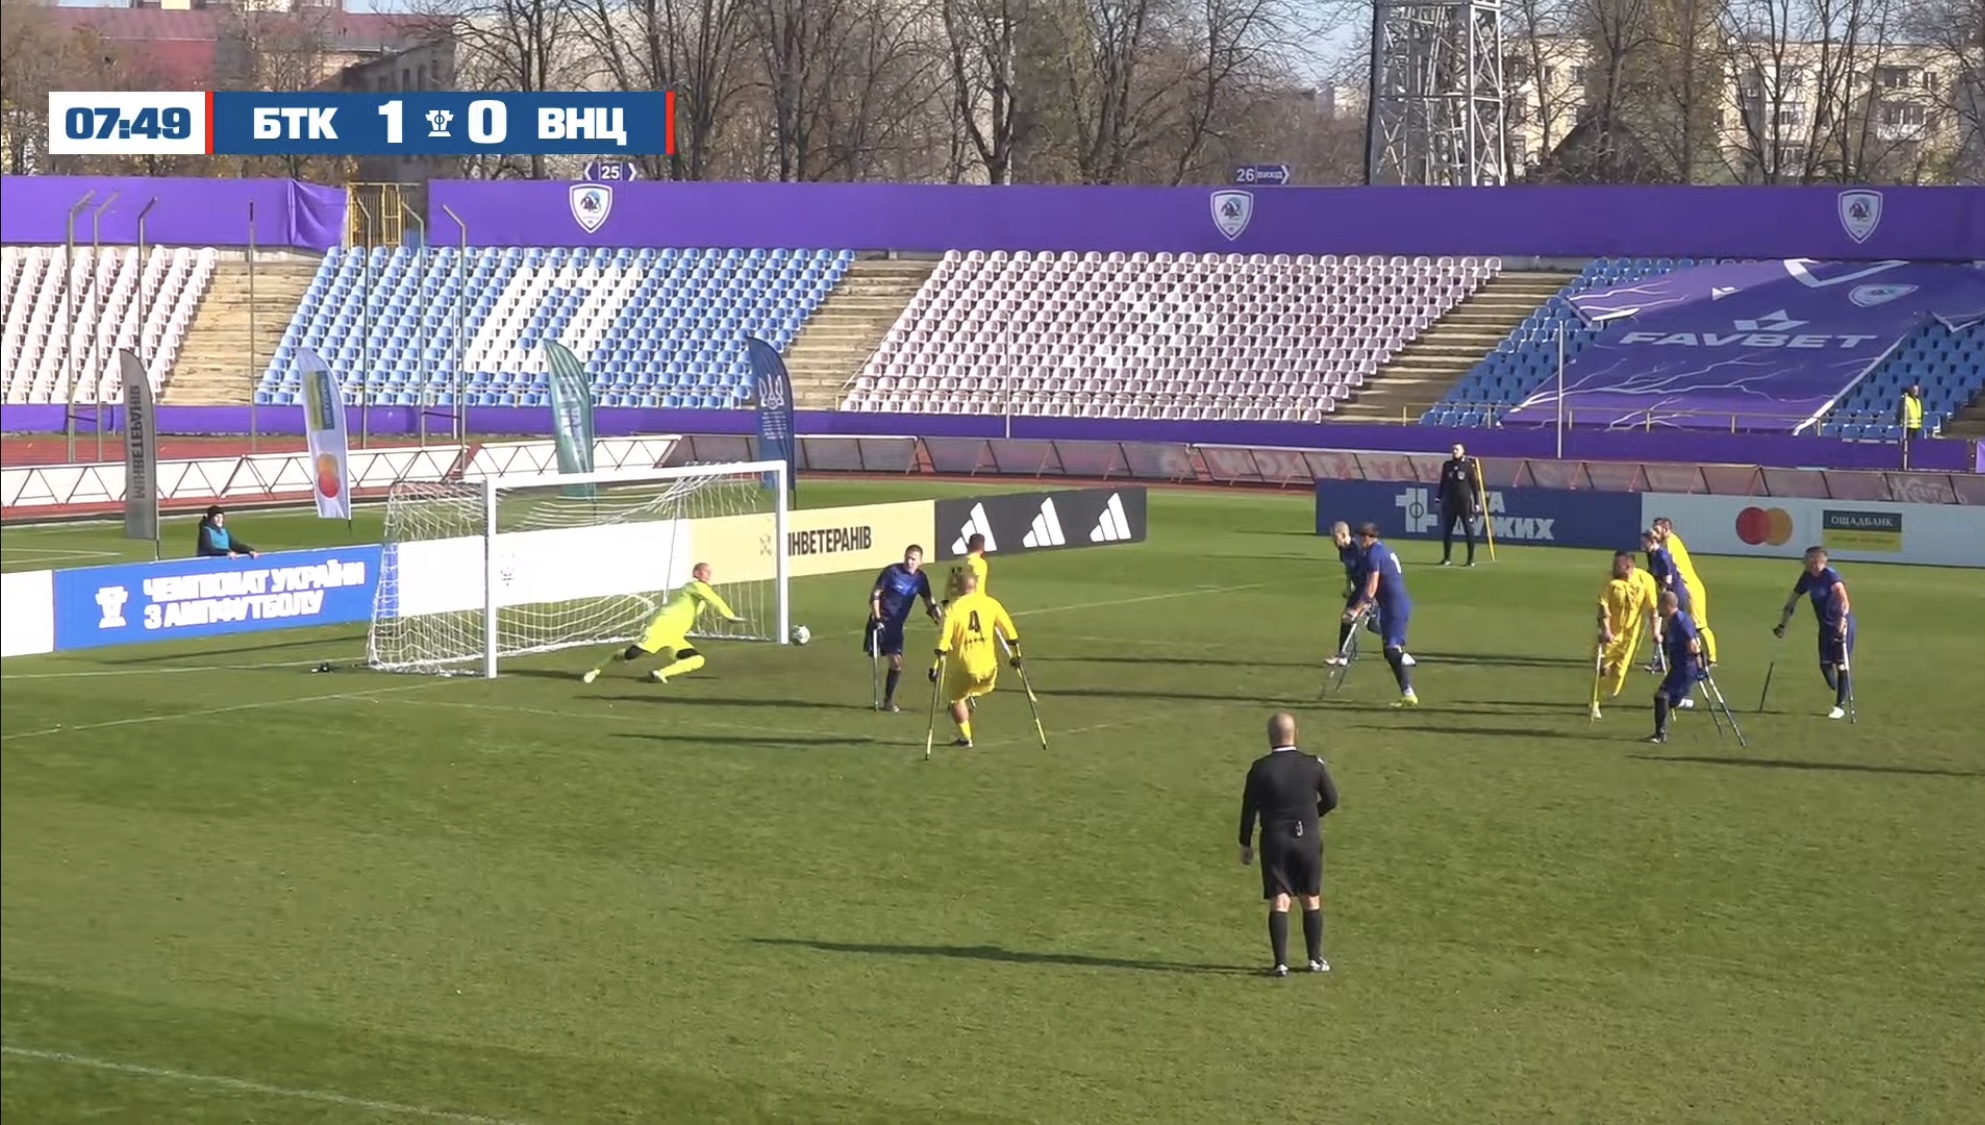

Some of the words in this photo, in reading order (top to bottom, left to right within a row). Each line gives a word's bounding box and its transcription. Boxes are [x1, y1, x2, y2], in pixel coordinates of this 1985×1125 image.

[601, 165, 620, 179] 25
[1236, 168, 1255, 182] 26
[1618, 331, 1878, 348] FAVBET
[1830, 515, 1894, 527] ОЩАДБАНК
[787, 525, 872, 557] ІНВЕТЕРАНІВ
[270, 558, 365, 593] УКРАЇНИ
[967, 610, 981, 633] 4
